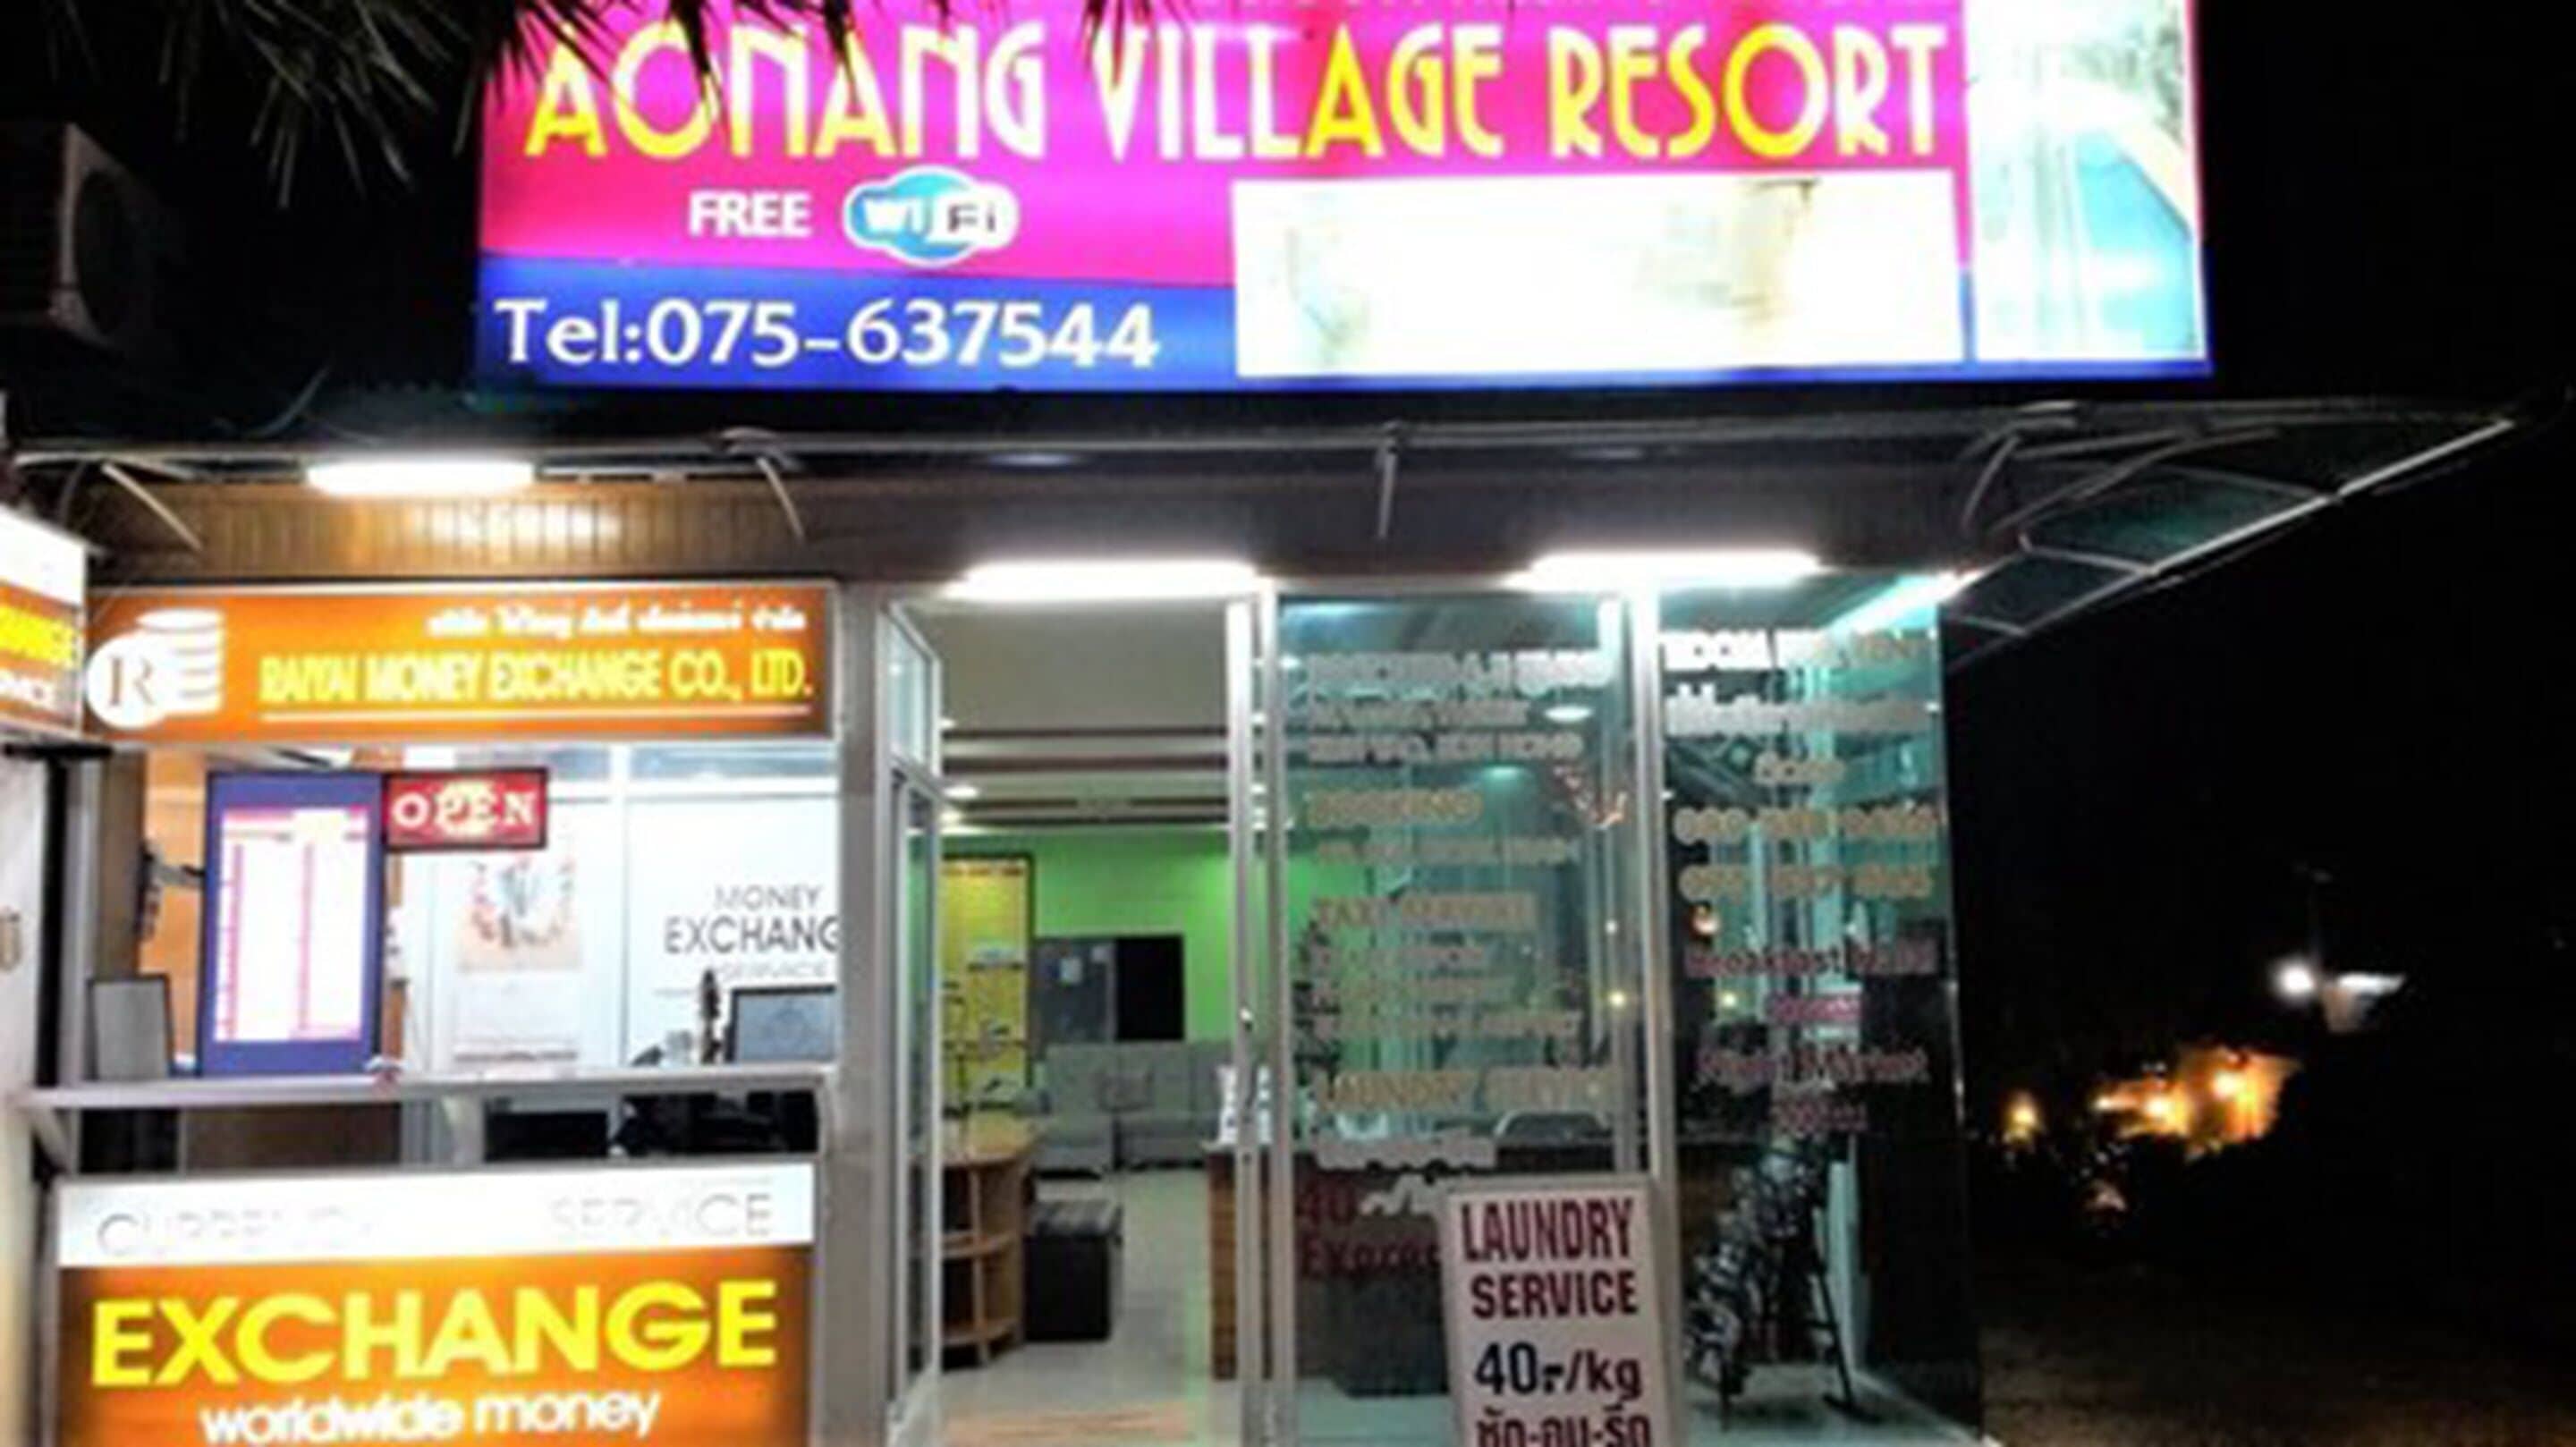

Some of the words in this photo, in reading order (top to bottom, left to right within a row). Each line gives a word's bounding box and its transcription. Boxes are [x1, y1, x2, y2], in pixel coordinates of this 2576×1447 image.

[524, 21, 1045, 159] AONANG
[1093, 21, 1504, 161] VILLAGE
[1548, 23, 1947, 159] RESORT
[689, 190, 812, 239] FREE
[494, 298, 1162, 368] Tel:075-637544
[363, 653, 487, 702] MONEY
[487, 649, 662, 701] EXCHANGE
[668, 648, 741, 701] CO.,
[749, 647, 813, 697] LTD.
[390, 791, 537, 830] OPEN
[715, 884, 823, 909] MONEY
[1461, 1196, 1634, 1263] LAUNDRY
[1470, 1269, 1639, 1320] SERVICE
[91, 1281, 778, 1386] EXCHANGE
[201, 1392, 463, 1443] worldwide
[477, 1388, 661, 1438] money
